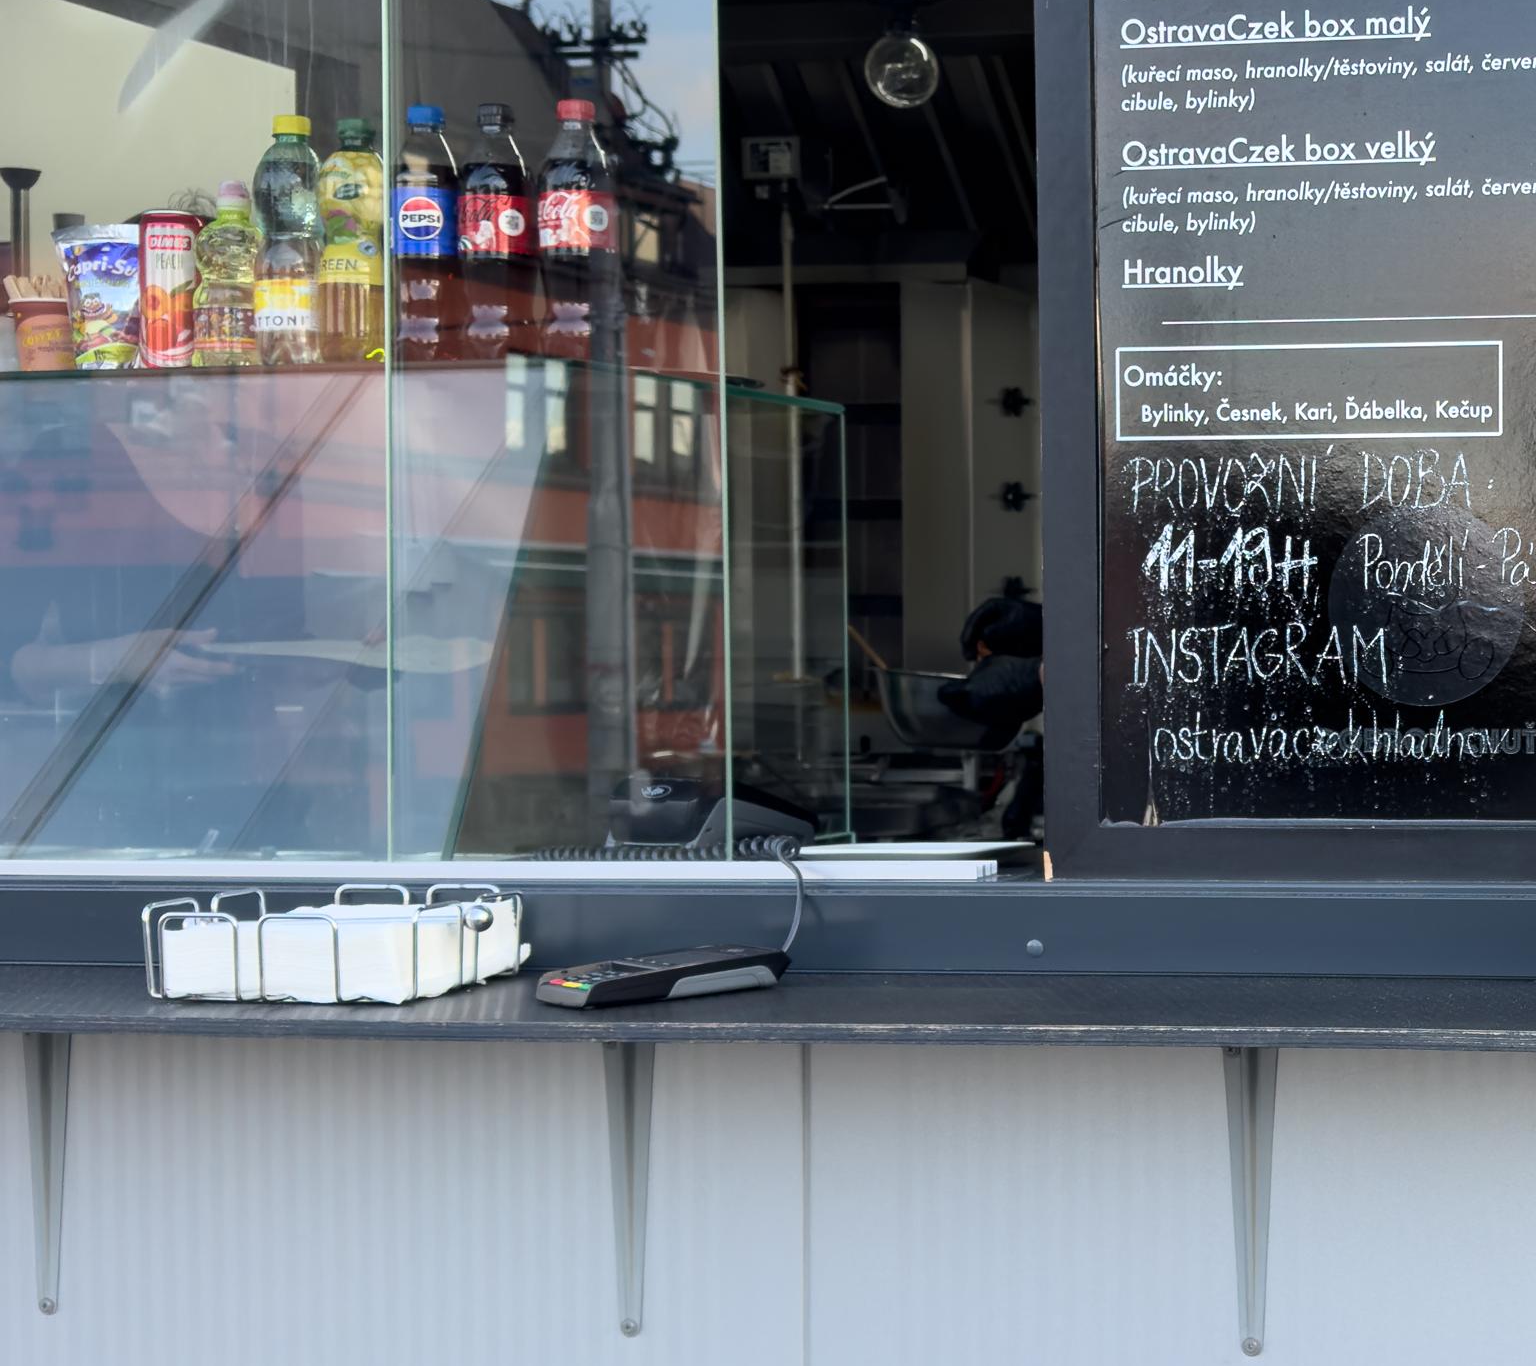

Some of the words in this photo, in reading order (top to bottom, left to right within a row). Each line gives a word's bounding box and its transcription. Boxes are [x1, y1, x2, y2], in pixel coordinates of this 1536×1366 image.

[1121, 12, 1293, 47] OstravaCzek
[1305, 11, 1354, 41] box
[1366, 7, 1430, 39] malý
[1122, 64, 1181, 88] (kuřecí
[1187, 67, 1237, 82] maso,
[1246, 56, 1417, 82] hranolky/těstoviny,
[1426, 53, 1473, 74] salát,
[1122, 91, 1177, 112] cibule,
[1186, 88, 1254, 114] bylinky)
[1123, 135, 1294, 170] OstravaCzek
[1306, 134, 1355, 164] box
[1365, 132, 1435, 163] velký
[1123, 186, 1182, 209] (kuřecí
[1188, 190, 1238, 205] maso,
[1246, 180, 1417, 206] hranolky/těstoviny,
[1426, 177, 1473, 199] salát,
[401, 214, 441, 224] PEPSI
[1123, 212, 1178, 234] cibule,
[1187, 211, 1255, 236] bylinky)
[151, 236, 189, 249] DIMES
[1125, 255, 1243, 288] Hranolky
[1123, 364, 1223, 390] Omáčky:
[1142, 402, 1209, 427] Bylinky,
[1217, 398, 1287, 424] Česnek,
[1296, 402, 1337, 423] Kari,
[1346, 395, 1427, 422] Ďábelka,
[1436, 400, 1492, 423] Kečup
[1126, 622, 1388, 686] INSTAGRAM
